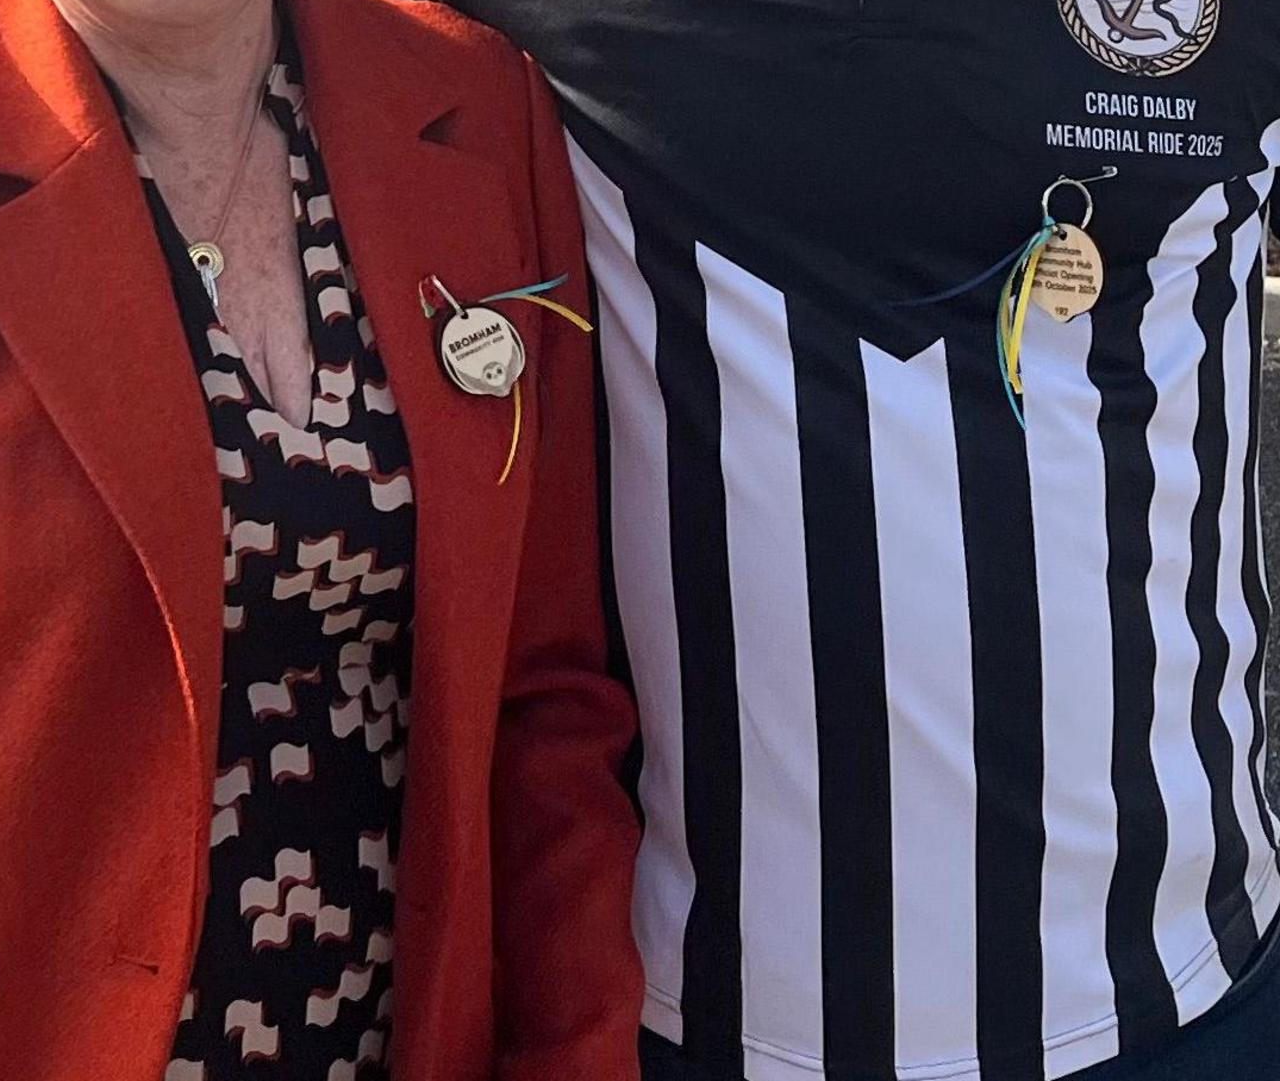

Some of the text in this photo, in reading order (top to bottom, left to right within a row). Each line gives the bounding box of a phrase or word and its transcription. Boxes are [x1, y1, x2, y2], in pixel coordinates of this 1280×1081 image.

[1085, 91, 1198, 121] CRAIG DALBY
[1046, 123, 1224, 157] MEMORIAL RIDE 2025
[449, 323, 502, 353] BROMHAM
